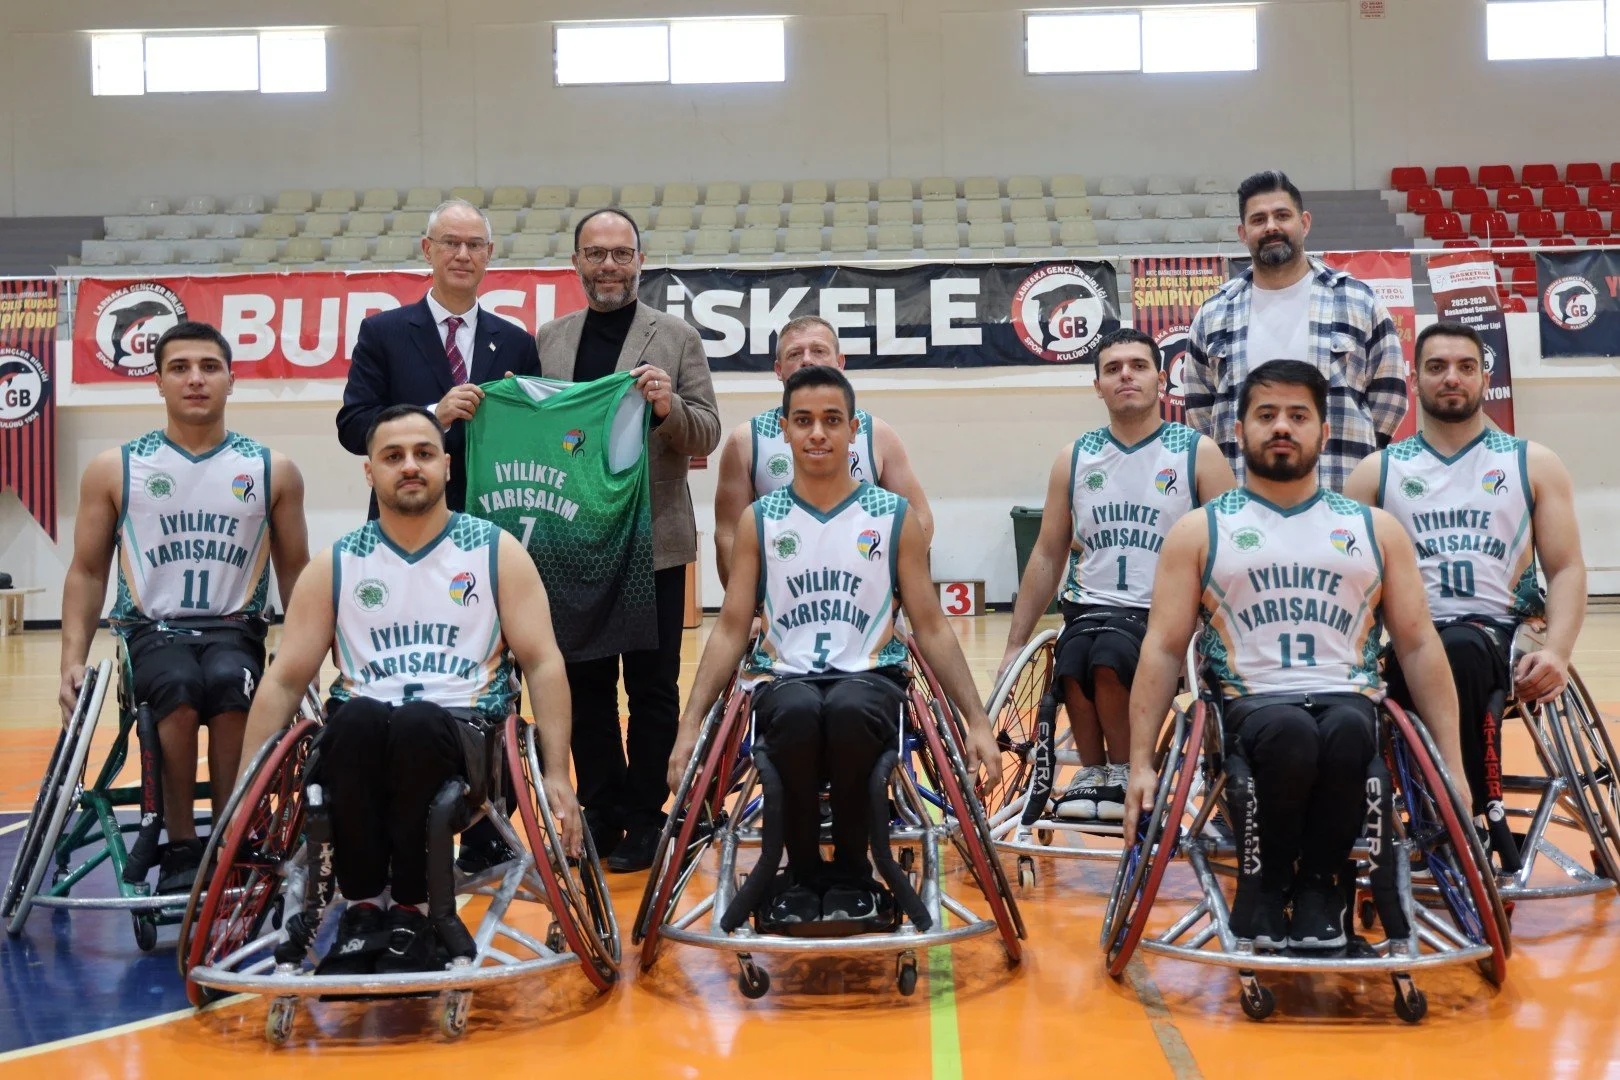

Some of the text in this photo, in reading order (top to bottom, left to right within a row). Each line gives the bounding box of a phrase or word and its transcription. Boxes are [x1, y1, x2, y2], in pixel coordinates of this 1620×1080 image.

[1016, 266, 1108, 302] LARNAKA GENÇLER BİRLİĞİ
[1134, 275, 1223, 289] 2023 AÇILIŞ KUPASI
[93, 283, 186, 316] LARNAKA GENÇLER BİRLİĞİ
[1444, 305, 1497, 317] Basketbol Sezonu
[1450, 296, 1487, 307] 2023-2024
[1570, 304, 1589, 317] GB
[0, 311, 57, 329] PİYONU
[667, 278, 983, 358] İSKELE
[1058, 316, 1089, 339] GB
[1460, 314, 1484, 324] Extend
[1489, 322, 1501, 331] Ligi
[95, 351, 115, 370] SPOR
[1024, 333, 1103, 361] SPOR KULÜBÜ 1934
[5, 389, 31, 408] GB
[494, 459, 568, 490] İYİLİKTE
[478, 487, 580, 522] YARIŞALIM
[1091, 500, 1161, 527] İYİLİKTE
[1412, 507, 1492, 534] İYİLİKTE
[159, 509, 240, 537] İYİLİKTE
[519, 516, 537, 550] 7
[145, 538, 249, 570] YARIŞALIM
[1415, 534, 1507, 561] ARIŞALIM
[786, 566, 863, 599] İYİLİKTE
[1116, 555, 1129, 591] 1
[1247, 562, 1343, 597] İYİLİKTE
[1437, 560, 1476, 598] 10
[180, 569, 210, 610] 11
[945, 581, 971, 616] 3
[776, 599, 871, 635] YARIŞALIM
[1237, 597, 1353, 636] YARIŞALIM
[369, 620, 460, 652] İYİLİKTE
[812, 632, 832, 669] 5
[359, 651, 479, 685] YARIŞALIM
[1036, 721, 1051, 796] EXTRA
[1483, 711, 1503, 798] ATAER
[1065, 788, 1098, 797] EXTRA
[1244, 800, 1253, 875] WHEELCHAIR
[1365, 776, 1382, 873] EXTRA
